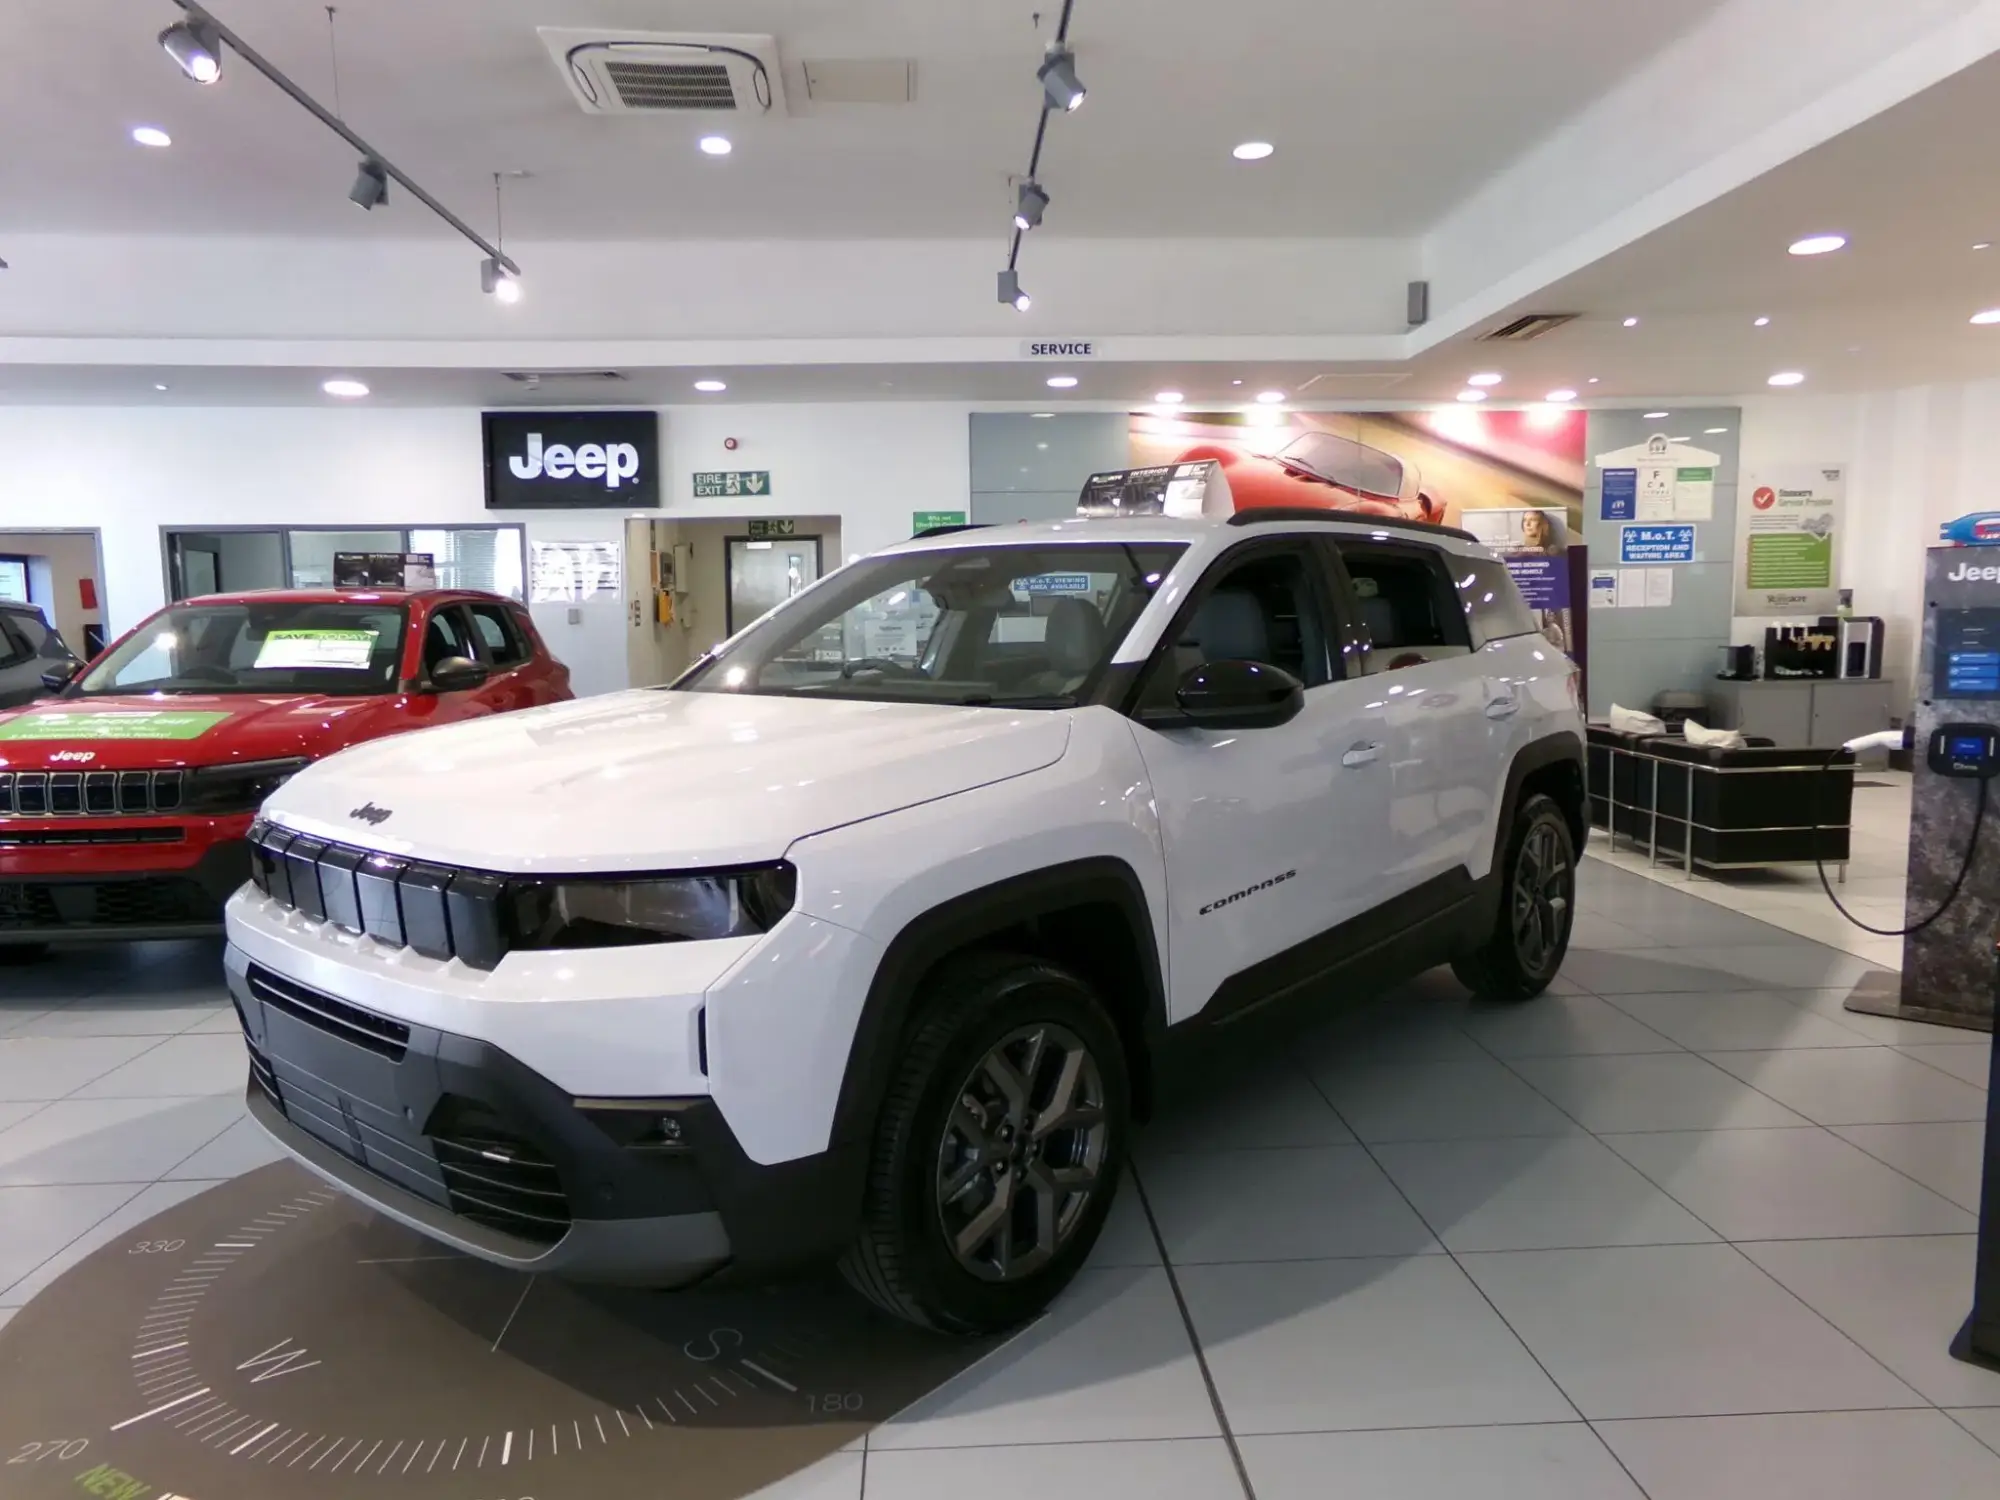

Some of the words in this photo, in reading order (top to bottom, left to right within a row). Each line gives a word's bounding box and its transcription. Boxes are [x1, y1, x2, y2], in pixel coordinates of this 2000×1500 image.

[1031, 343, 1092, 355] SERVICE
[508, 432, 640, 488] Jeep
[696, 474, 722, 484] FIRE
[697, 485, 722, 495] EXIT
[1640, 530, 1676, 541] M.o.T.
[1626, 544, 1670, 552] RECEPTION
[1672, 543, 1690, 551] AND
[1629, 552, 1662, 560] WAITING
[1664, 551, 1686, 559] AREA
[1947, 562, 2000, 584] Jee
[273, 633, 316, 641] SAVE
[49, 750, 96, 763] Jeep
[349, 801, 394, 826] Jeep
[128, 1238, 187, 1255] 330
[683, 1327, 744, 1362] S
[235, 1336, 323, 1384] W
[804, 1392, 865, 1414] 180
[5, 1437, 90, 1465] 270
